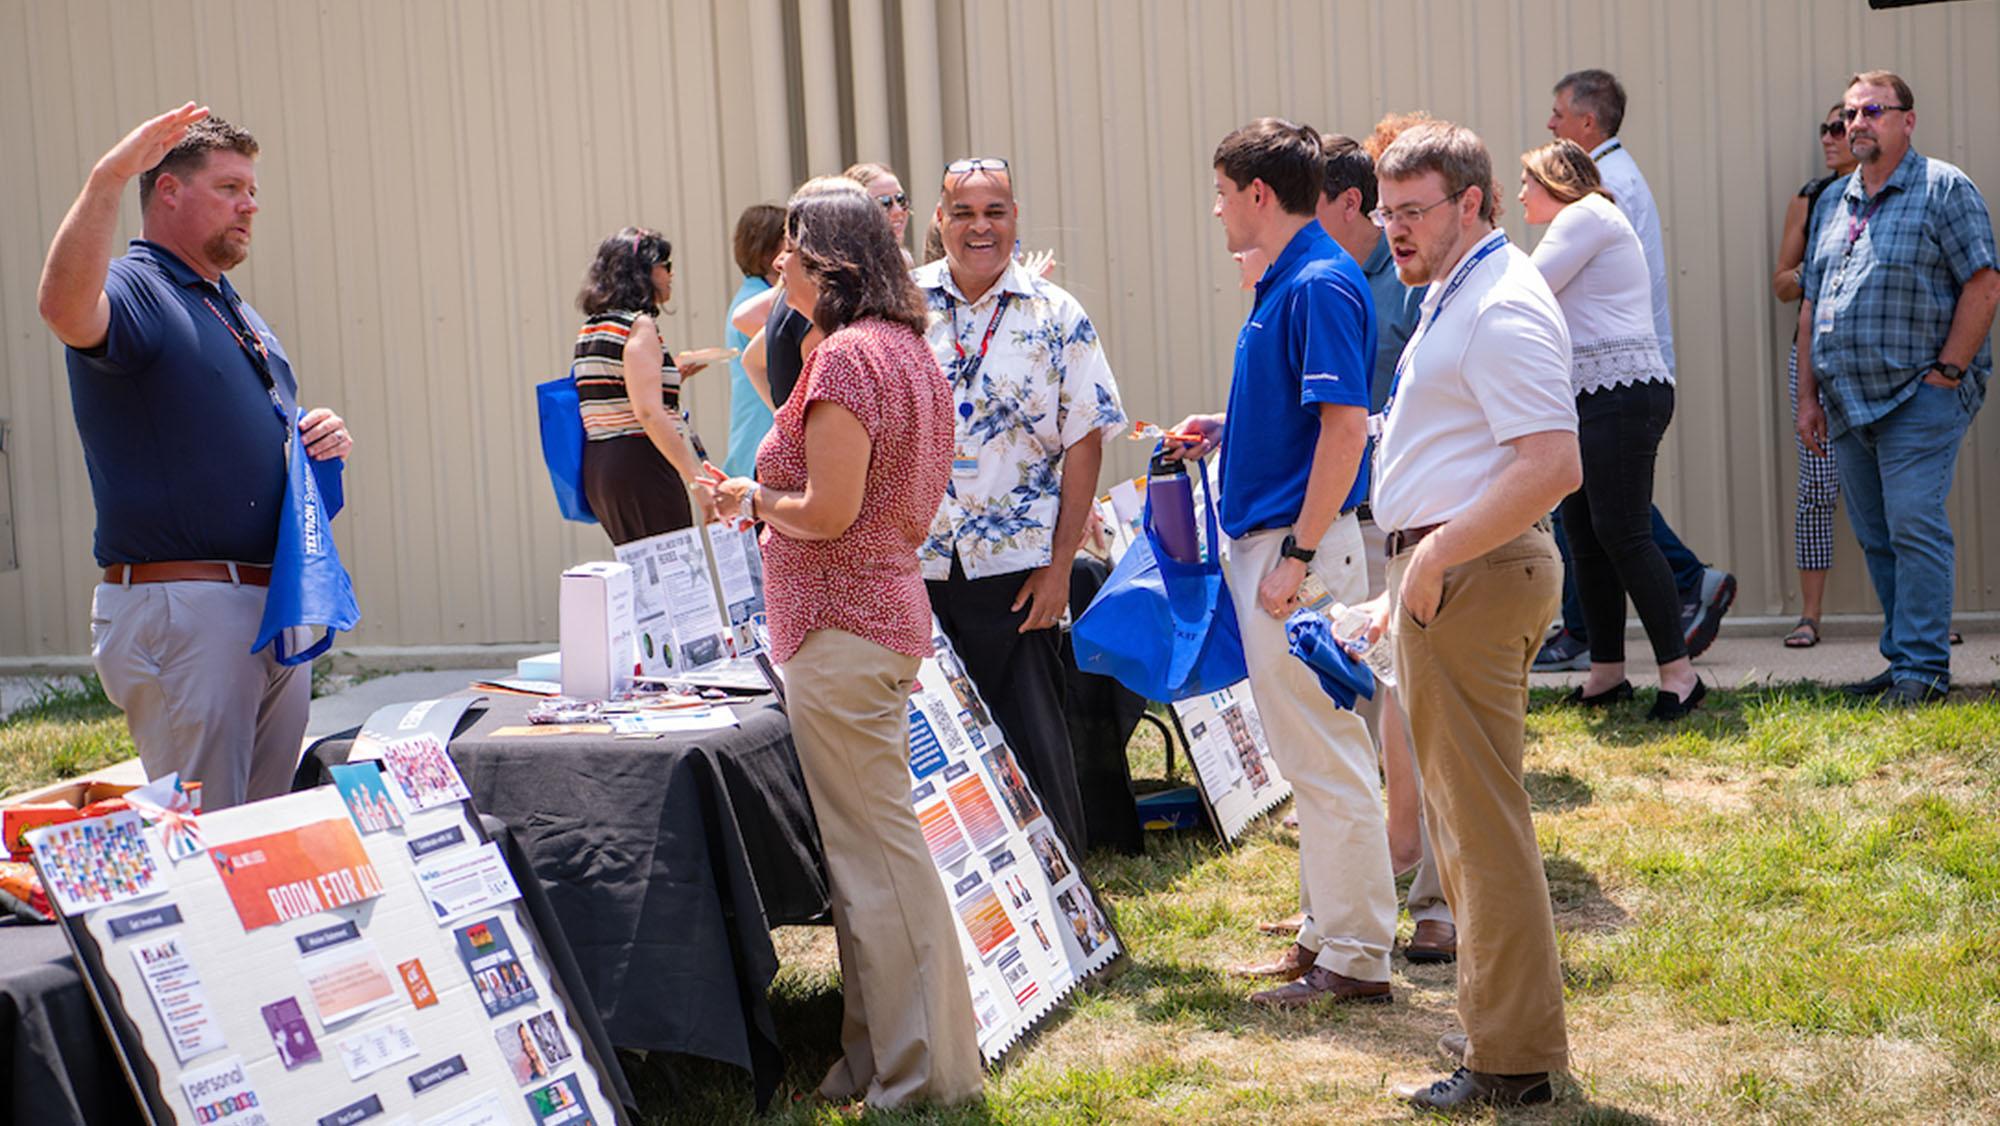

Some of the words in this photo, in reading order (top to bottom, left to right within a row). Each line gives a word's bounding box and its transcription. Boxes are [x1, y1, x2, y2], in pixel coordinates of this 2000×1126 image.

[304, 503, 318, 554] TEXTRON
[267, 879, 323, 922] ROOM
[317, 867, 363, 909] FOR
[140, 940, 180, 965] BLACK
[188, 1062, 245, 1105] personal
